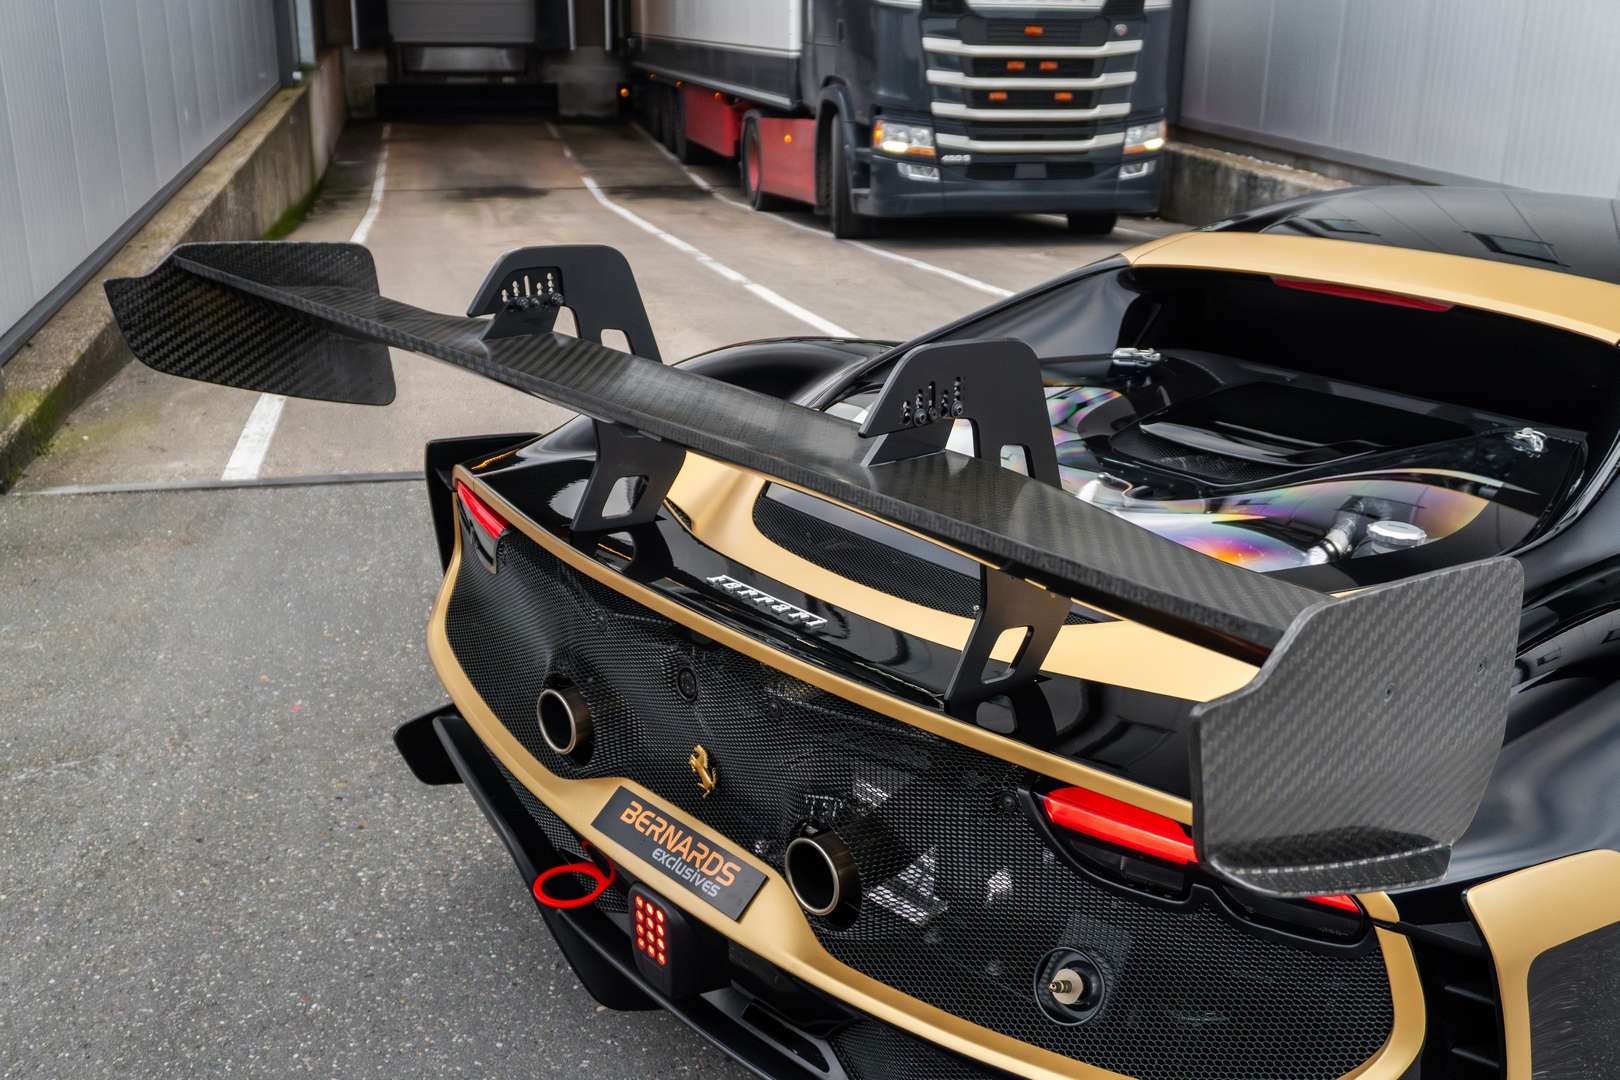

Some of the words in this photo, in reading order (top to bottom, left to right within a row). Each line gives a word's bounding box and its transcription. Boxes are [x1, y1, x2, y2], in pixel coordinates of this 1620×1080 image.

[706, 575, 828, 627] Ferrari
[619, 801, 741, 887] BERNARDS
[652, 848, 720, 897] exclusives
